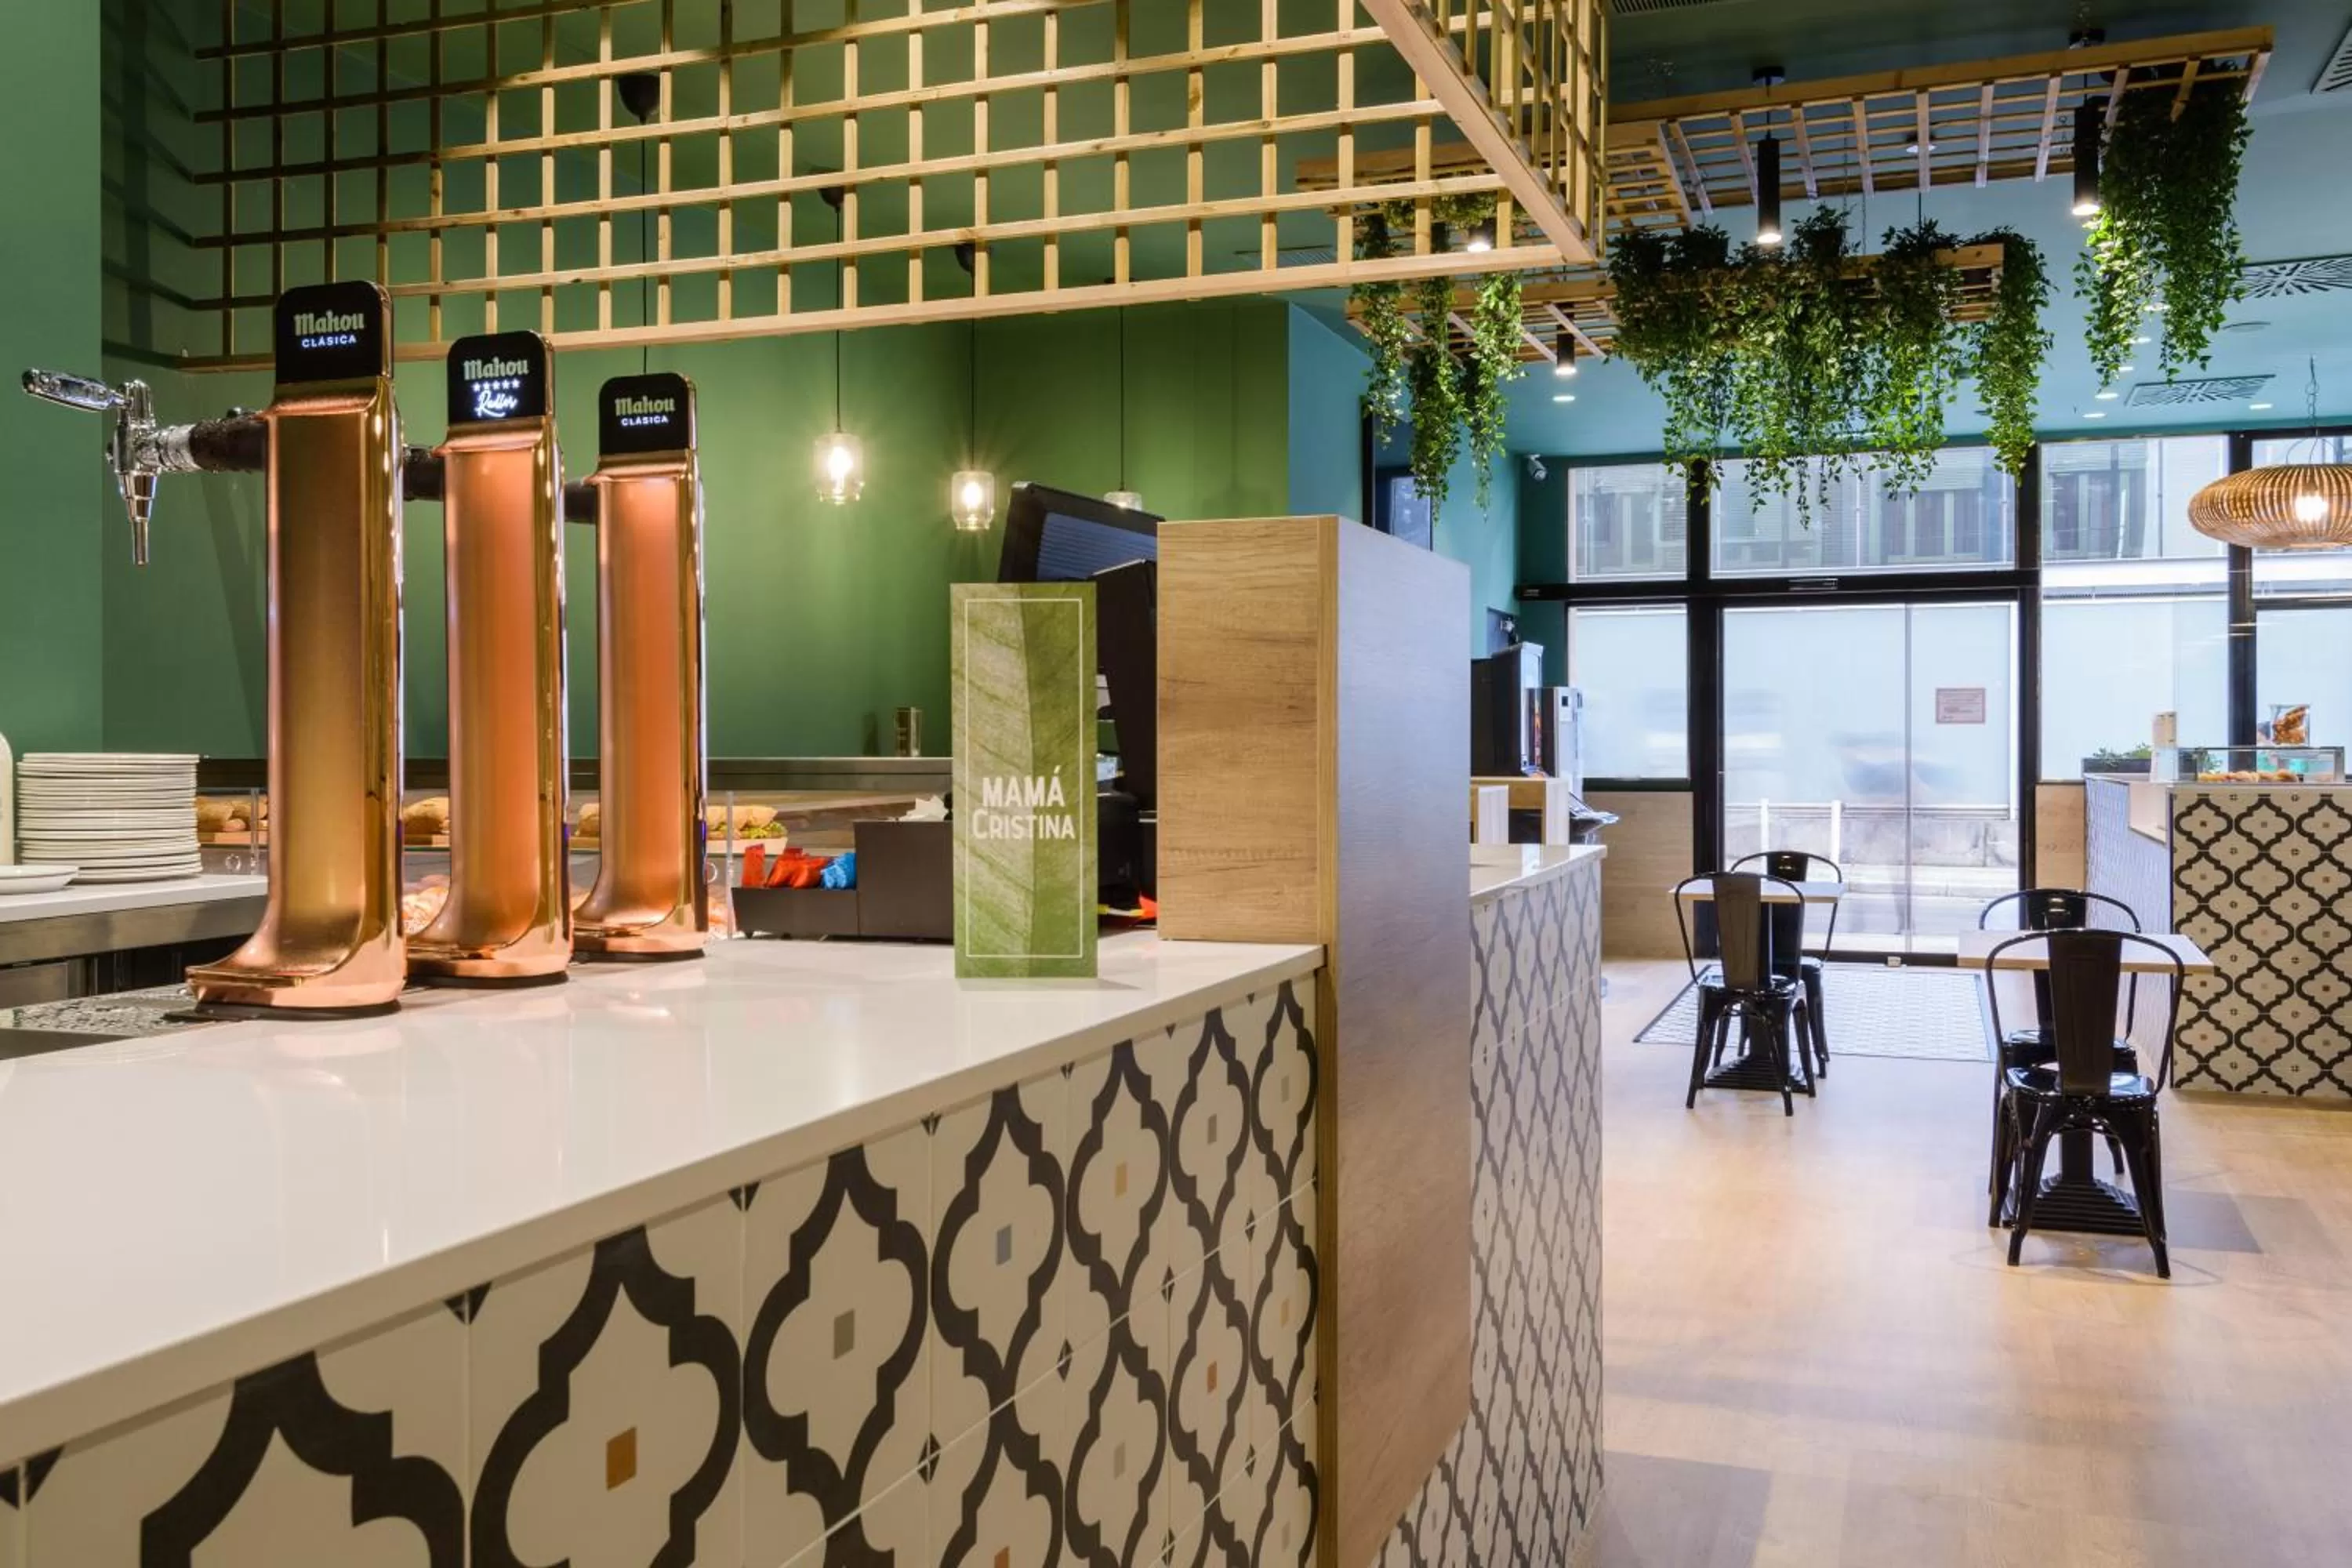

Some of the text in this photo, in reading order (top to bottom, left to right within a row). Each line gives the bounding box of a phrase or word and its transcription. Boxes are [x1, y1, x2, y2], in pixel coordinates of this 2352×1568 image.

[293, 309, 365, 336] Mahou
[463, 356, 529, 381] Mahou
[615, 395, 675, 416] Mahou
[982, 764, 1066, 808] MAMÁ
[972, 808, 1076, 840] CRISTINA
